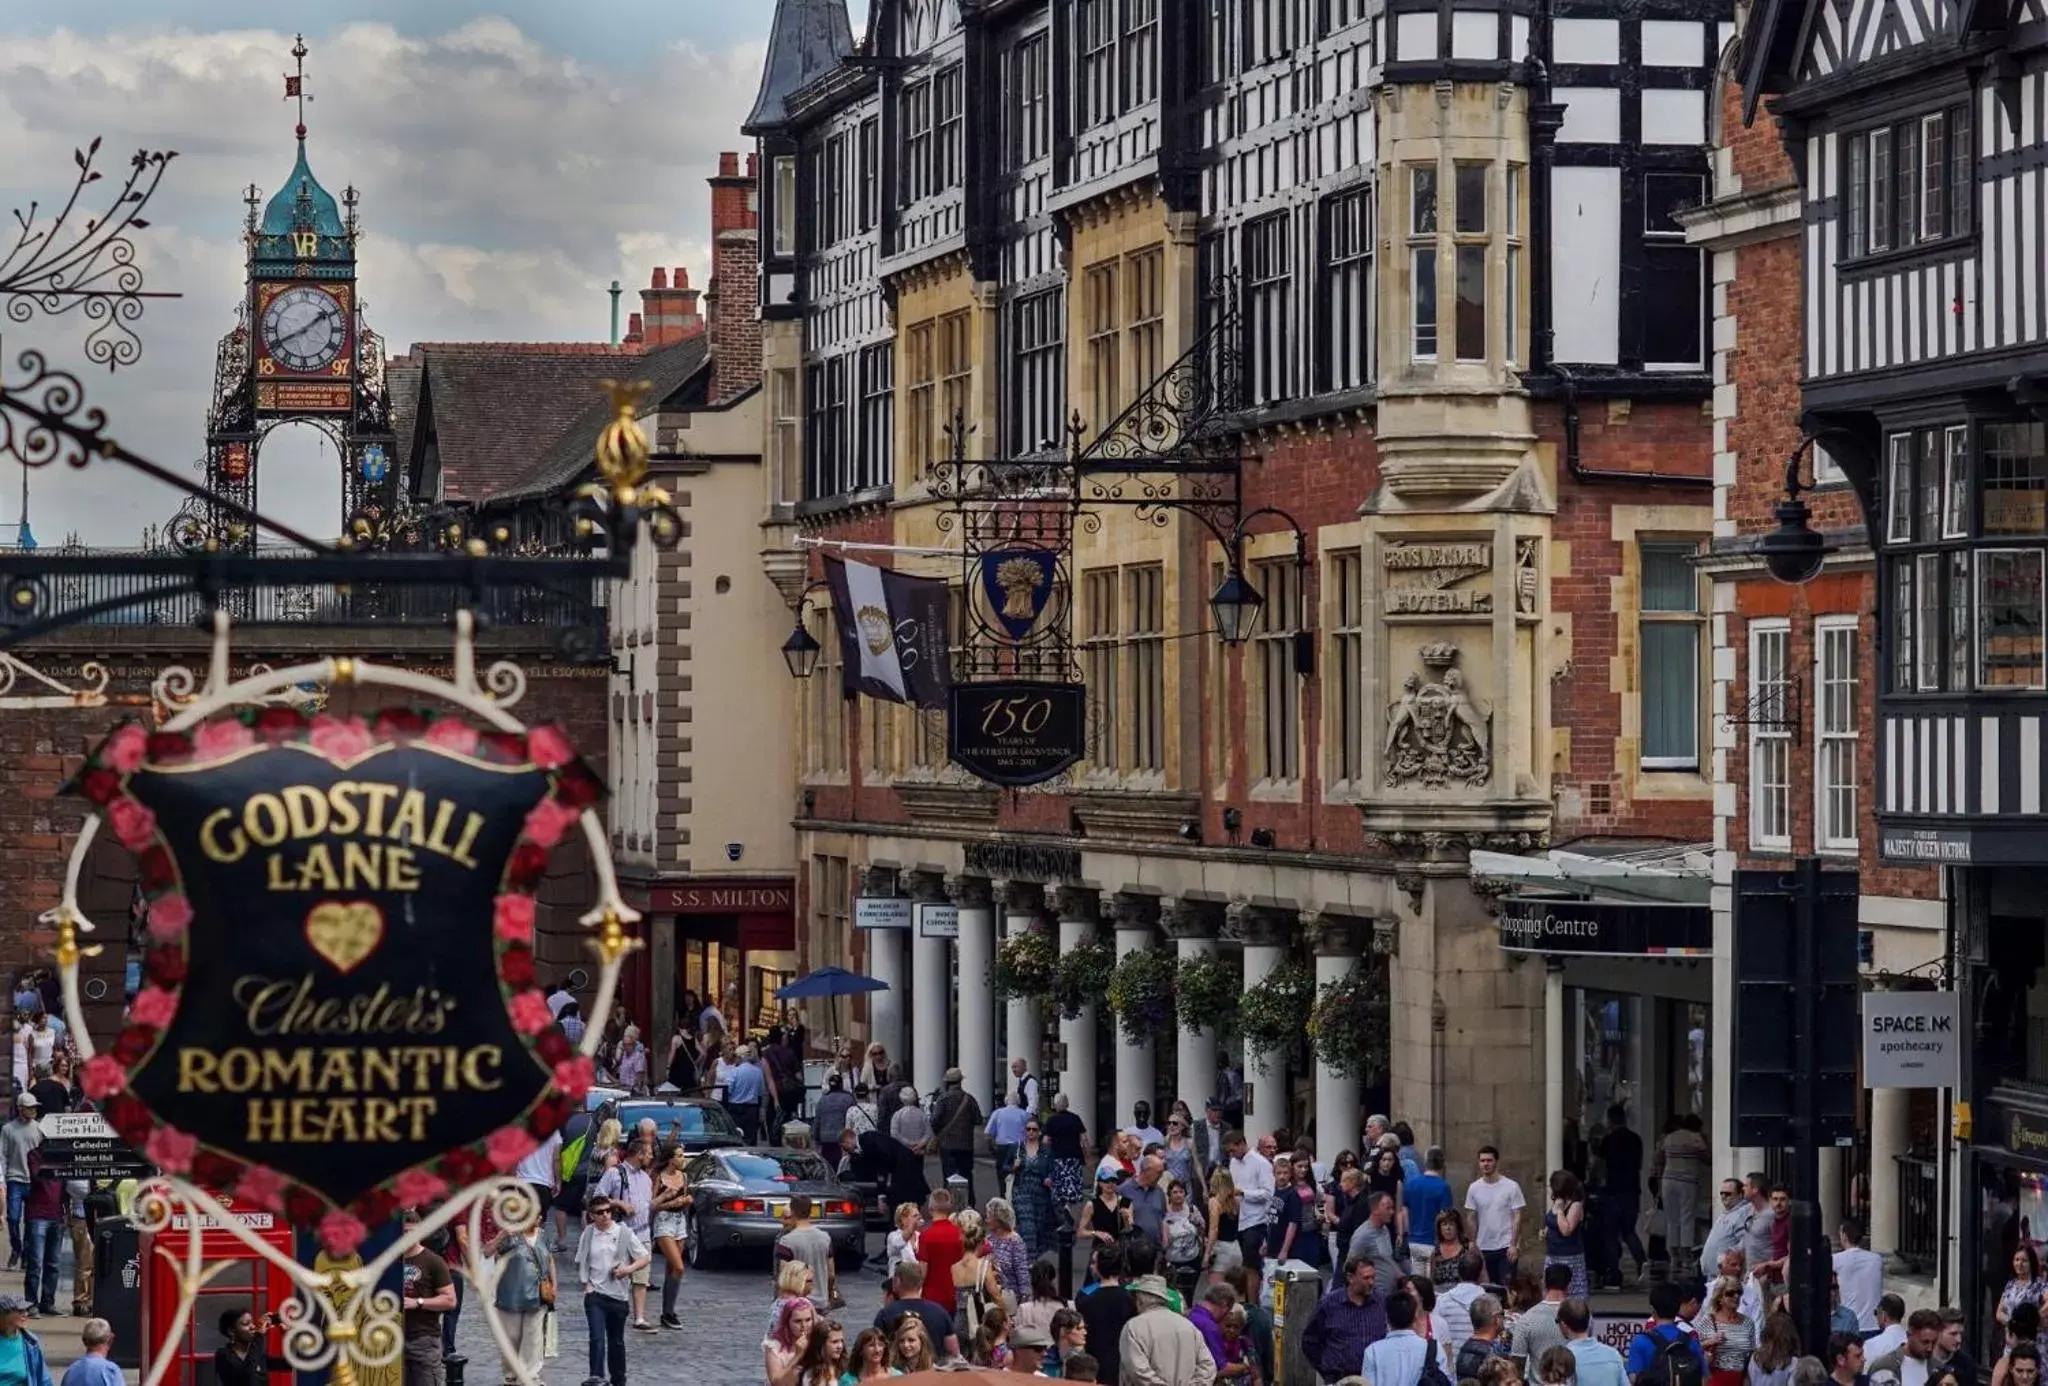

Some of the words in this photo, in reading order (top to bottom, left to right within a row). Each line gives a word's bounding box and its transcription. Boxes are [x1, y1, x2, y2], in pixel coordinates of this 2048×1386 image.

[332, 358, 350, 375] 97
[982, 693, 1051, 736] 150
[199, 780, 485, 869] GODSTALL
[1884, 840, 1914, 857] MAJESTY
[1916, 841, 1940, 858] QUEEN
[1941, 842, 1971, 861] VICTORIA
[267, 841, 422, 891] LANE
[671, 890, 706, 907] S.S.
[712, 889, 790, 907] MILTON
[1545, 914, 1599, 937] Centre
[232, 970, 457, 1037] Chester's
[1880, 1038, 1944, 1056] apothecary
[176, 1045, 503, 1094] ROMANTIC
[82, 1125, 105, 1133] Hall
[246, 1096, 437, 1142] HEART
[73, 1141, 112, 1149] Cathedral
[1606, 1323, 1643, 1335] HOLD
